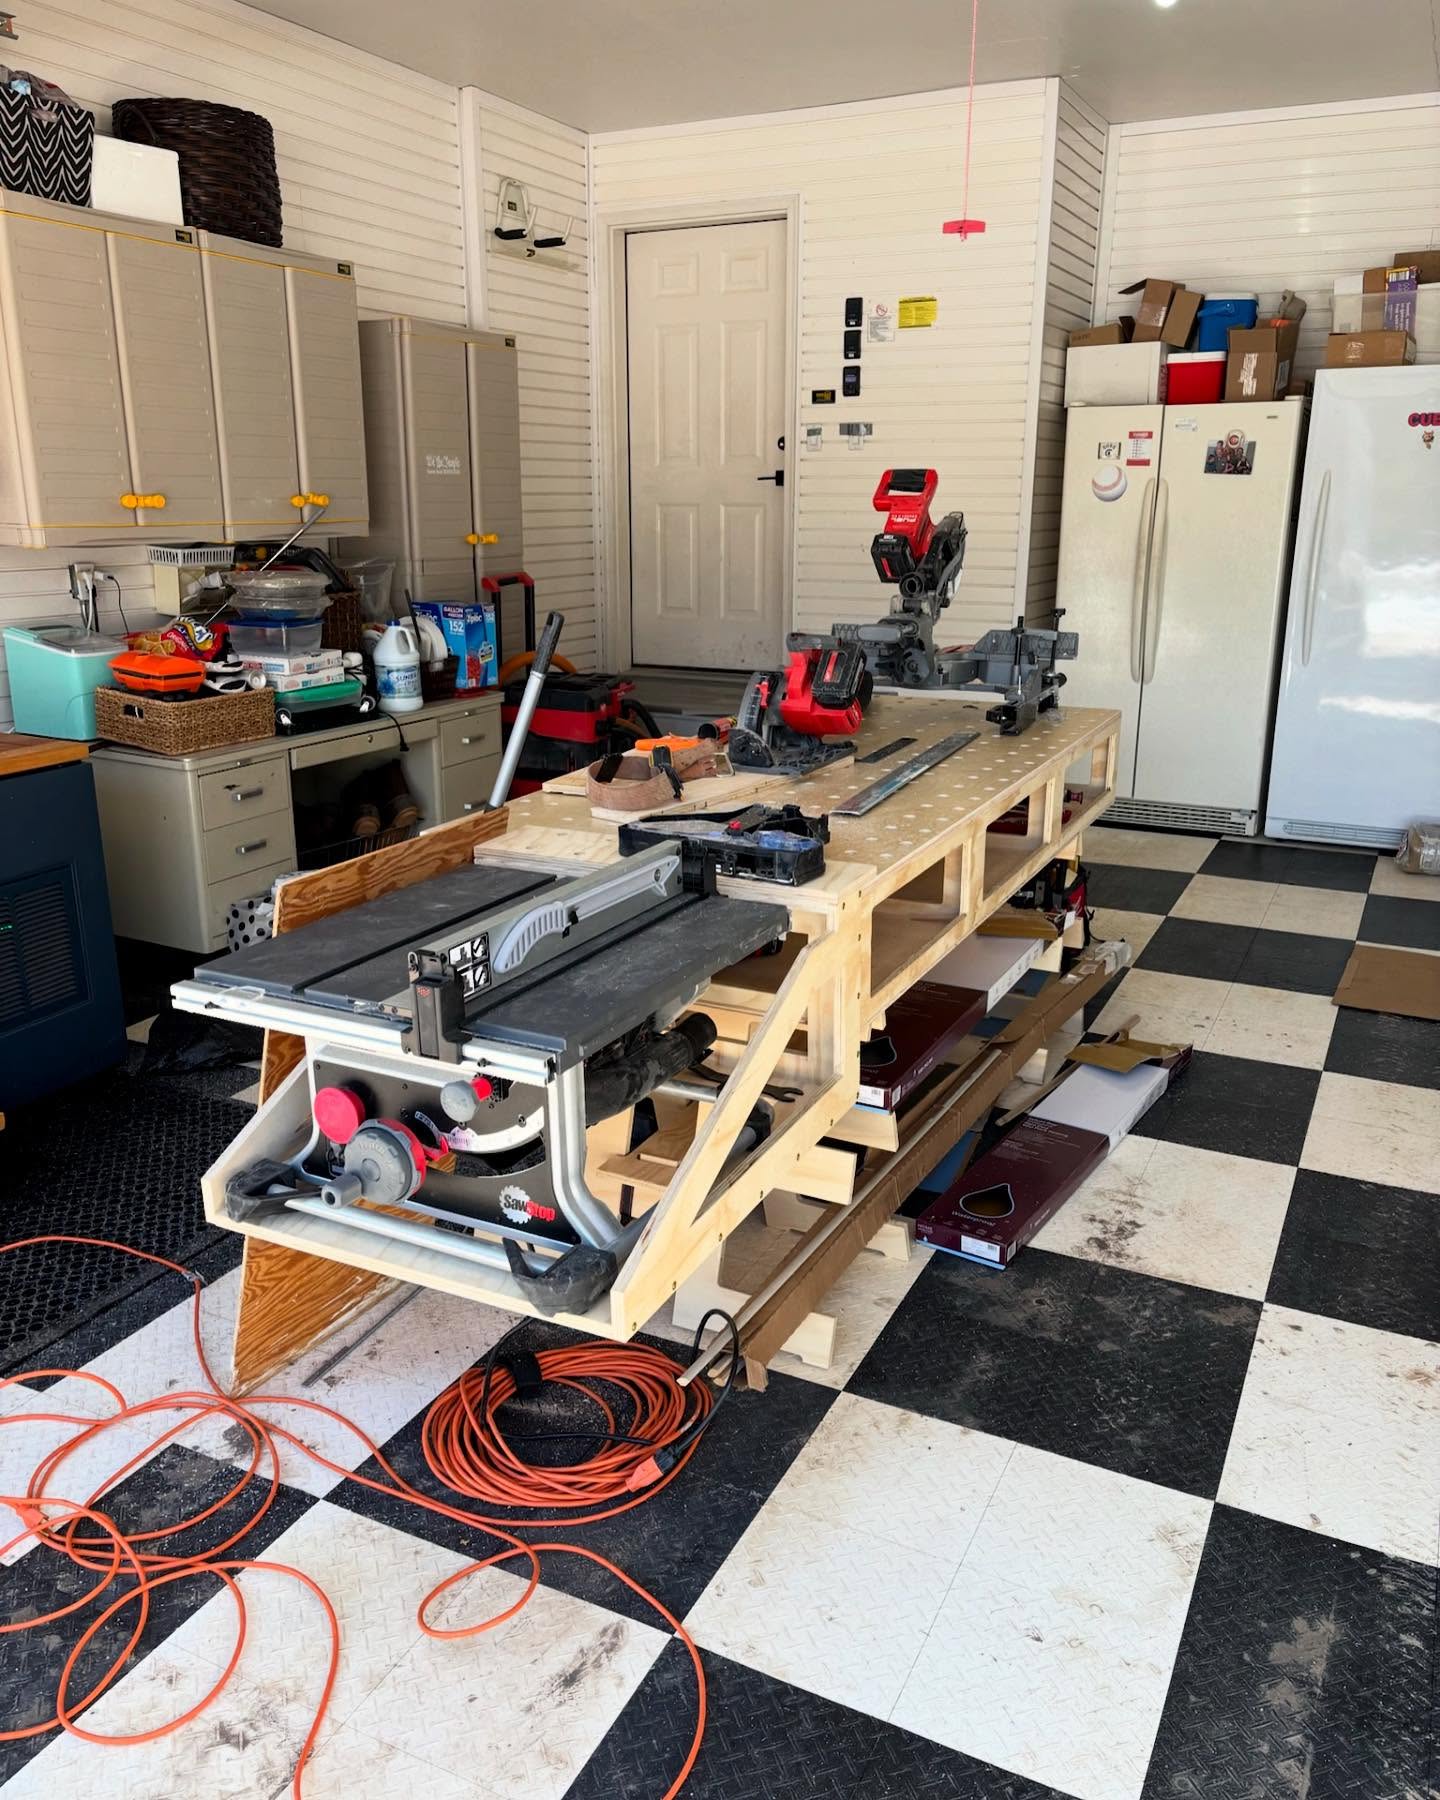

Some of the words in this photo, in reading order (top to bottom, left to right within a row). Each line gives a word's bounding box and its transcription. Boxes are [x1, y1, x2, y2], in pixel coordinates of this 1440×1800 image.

[449, 620, 464, 632] 152
[504, 1194, 556, 1222] SawStop
[951, 1210, 996, 1227] Waterproof
